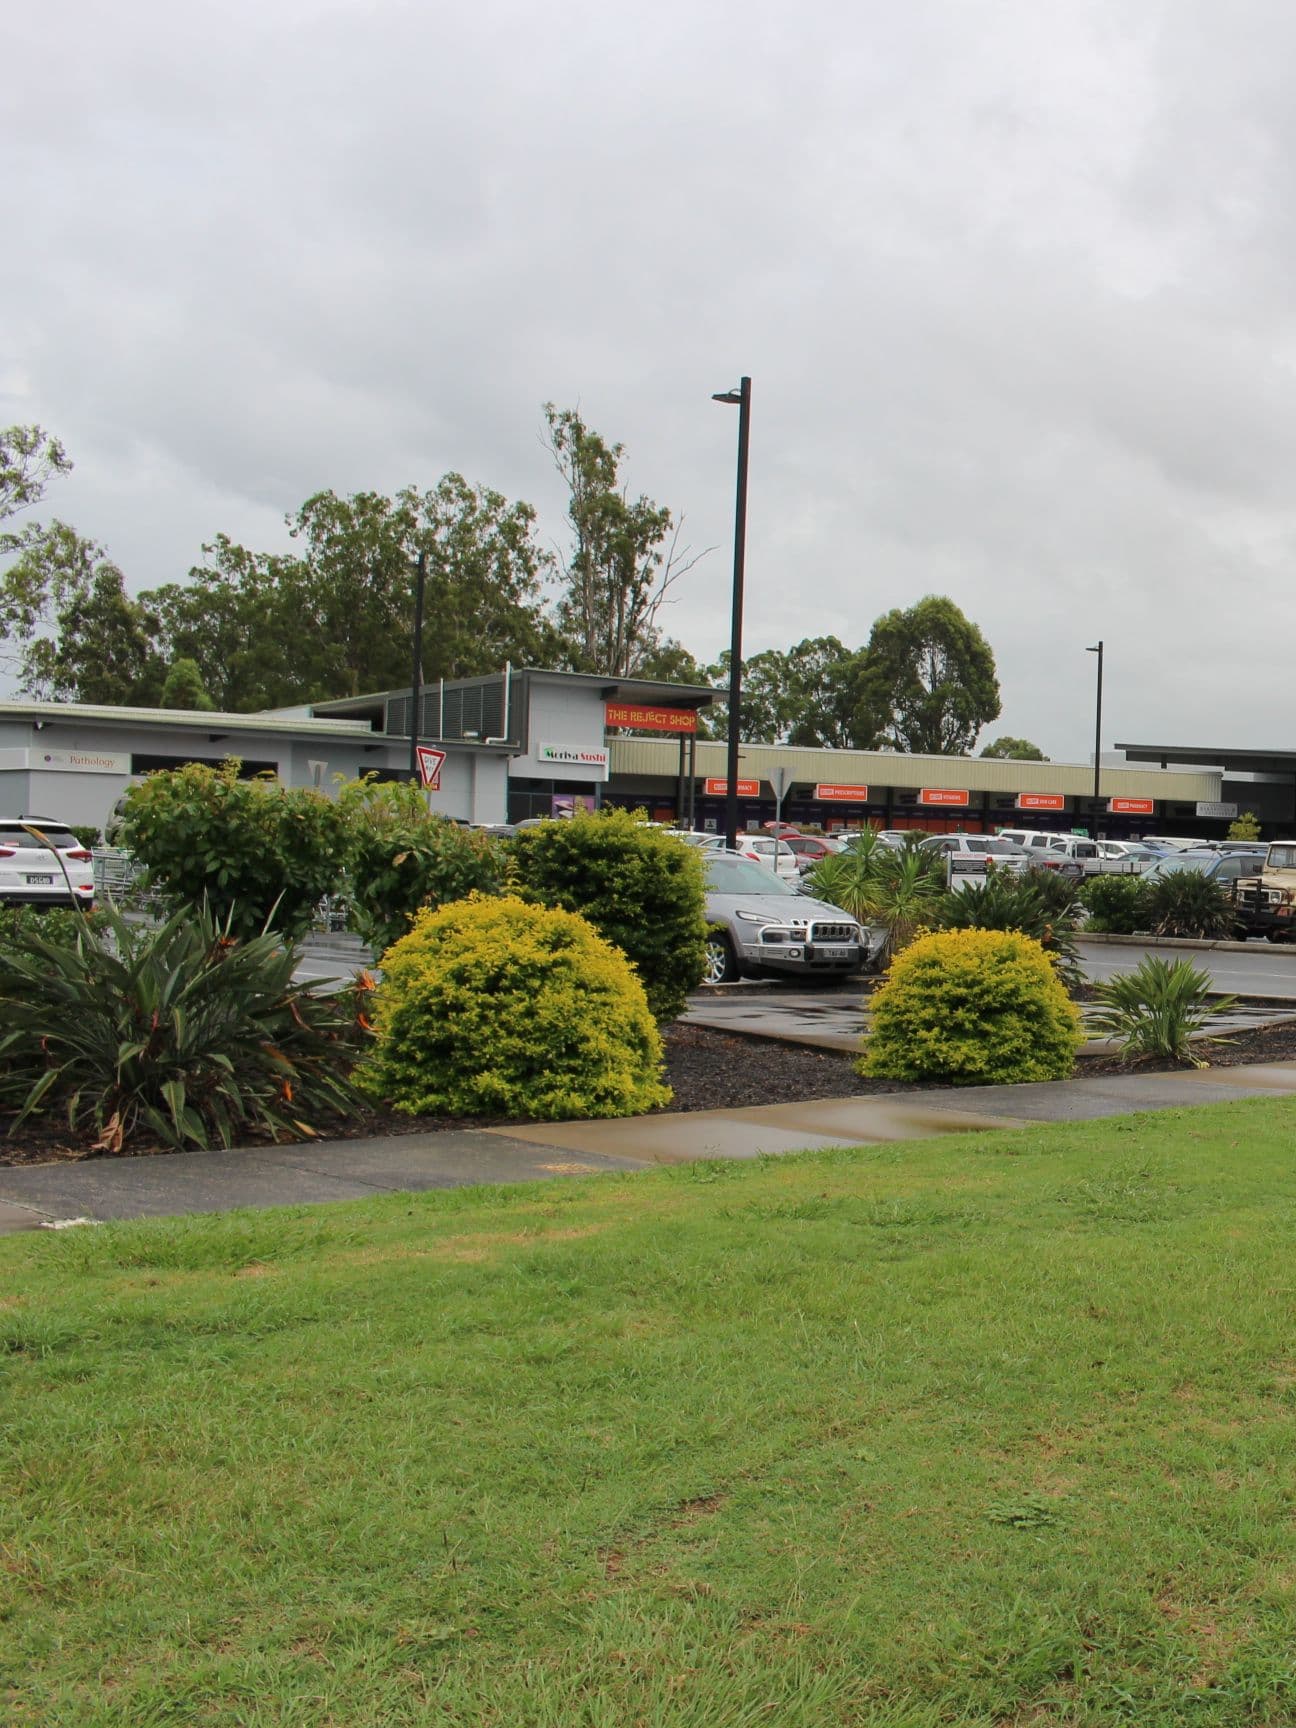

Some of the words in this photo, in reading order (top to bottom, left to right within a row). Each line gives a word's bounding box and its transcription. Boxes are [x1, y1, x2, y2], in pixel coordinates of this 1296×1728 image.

[608, 709, 627, 721] THE
[630, 711, 667, 724] REJECT
[670, 714, 695, 727] SHOP
[70, 755, 114, 768] Pathology
[580, 752, 606, 762] Sushi
